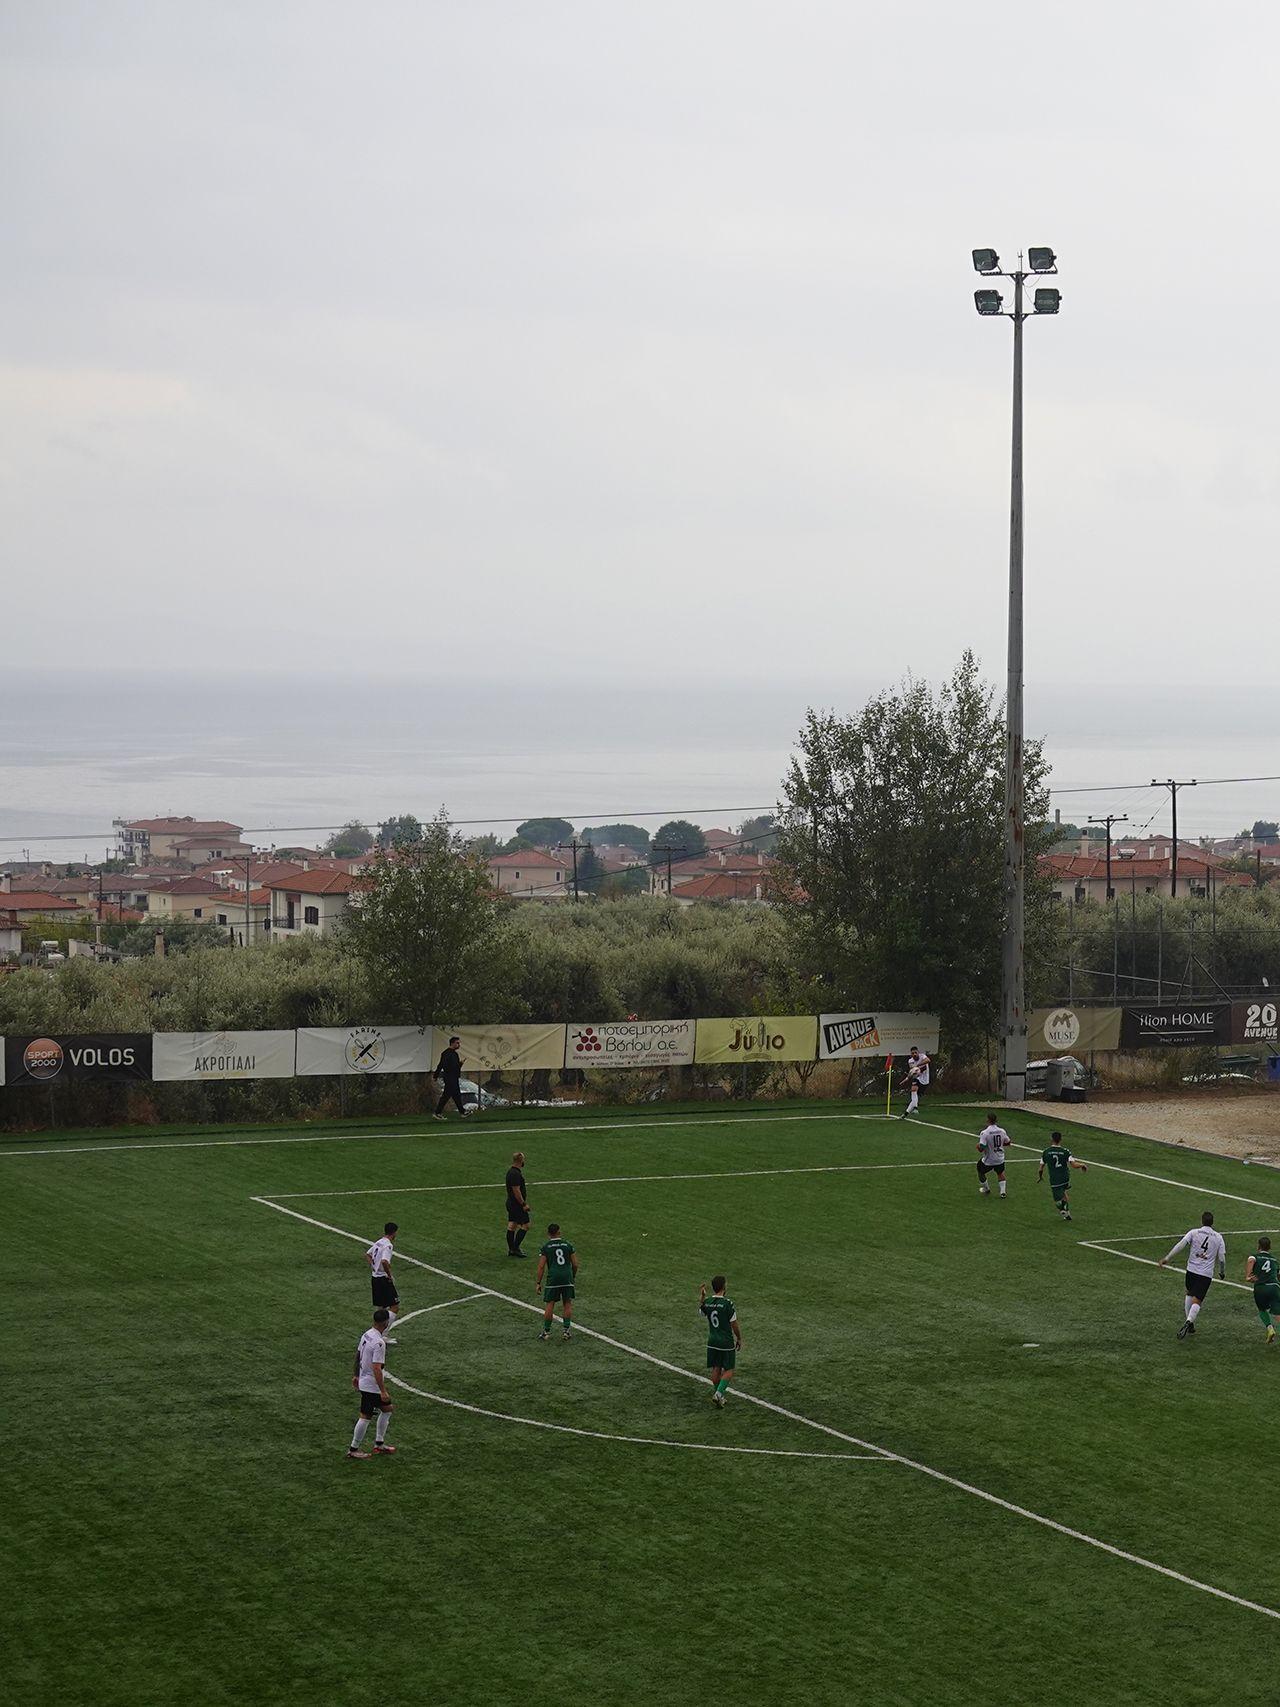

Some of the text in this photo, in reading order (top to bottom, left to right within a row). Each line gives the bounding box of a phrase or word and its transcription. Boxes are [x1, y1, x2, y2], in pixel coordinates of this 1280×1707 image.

[1172, 1012, 1214, 1026] HOME
[1246, 1003, 1277, 1028] 20
[828, 1019, 873, 1051] AVENUE
[854, 1032, 879, 1049] PACK
[1244, 1027, 1278, 1038] AVENUE
[27, 1050, 59, 1059] SPORT
[69, 1048, 135, 1066] VOLOS
[31, 1059, 56, 1067] 2000
[195, 1055, 256, 1072] ΑΚΡΟΓΙΑΛΙ
[993, 1135, 1002, 1148] 10
[1052, 1155, 1063, 1168] 2
[1201, 1236, 1209, 1252] 4
[555, 1248, 565, 1265] 8
[1261, 1260, 1271, 1273] 4
[710, 1310, 719, 1328] 6
